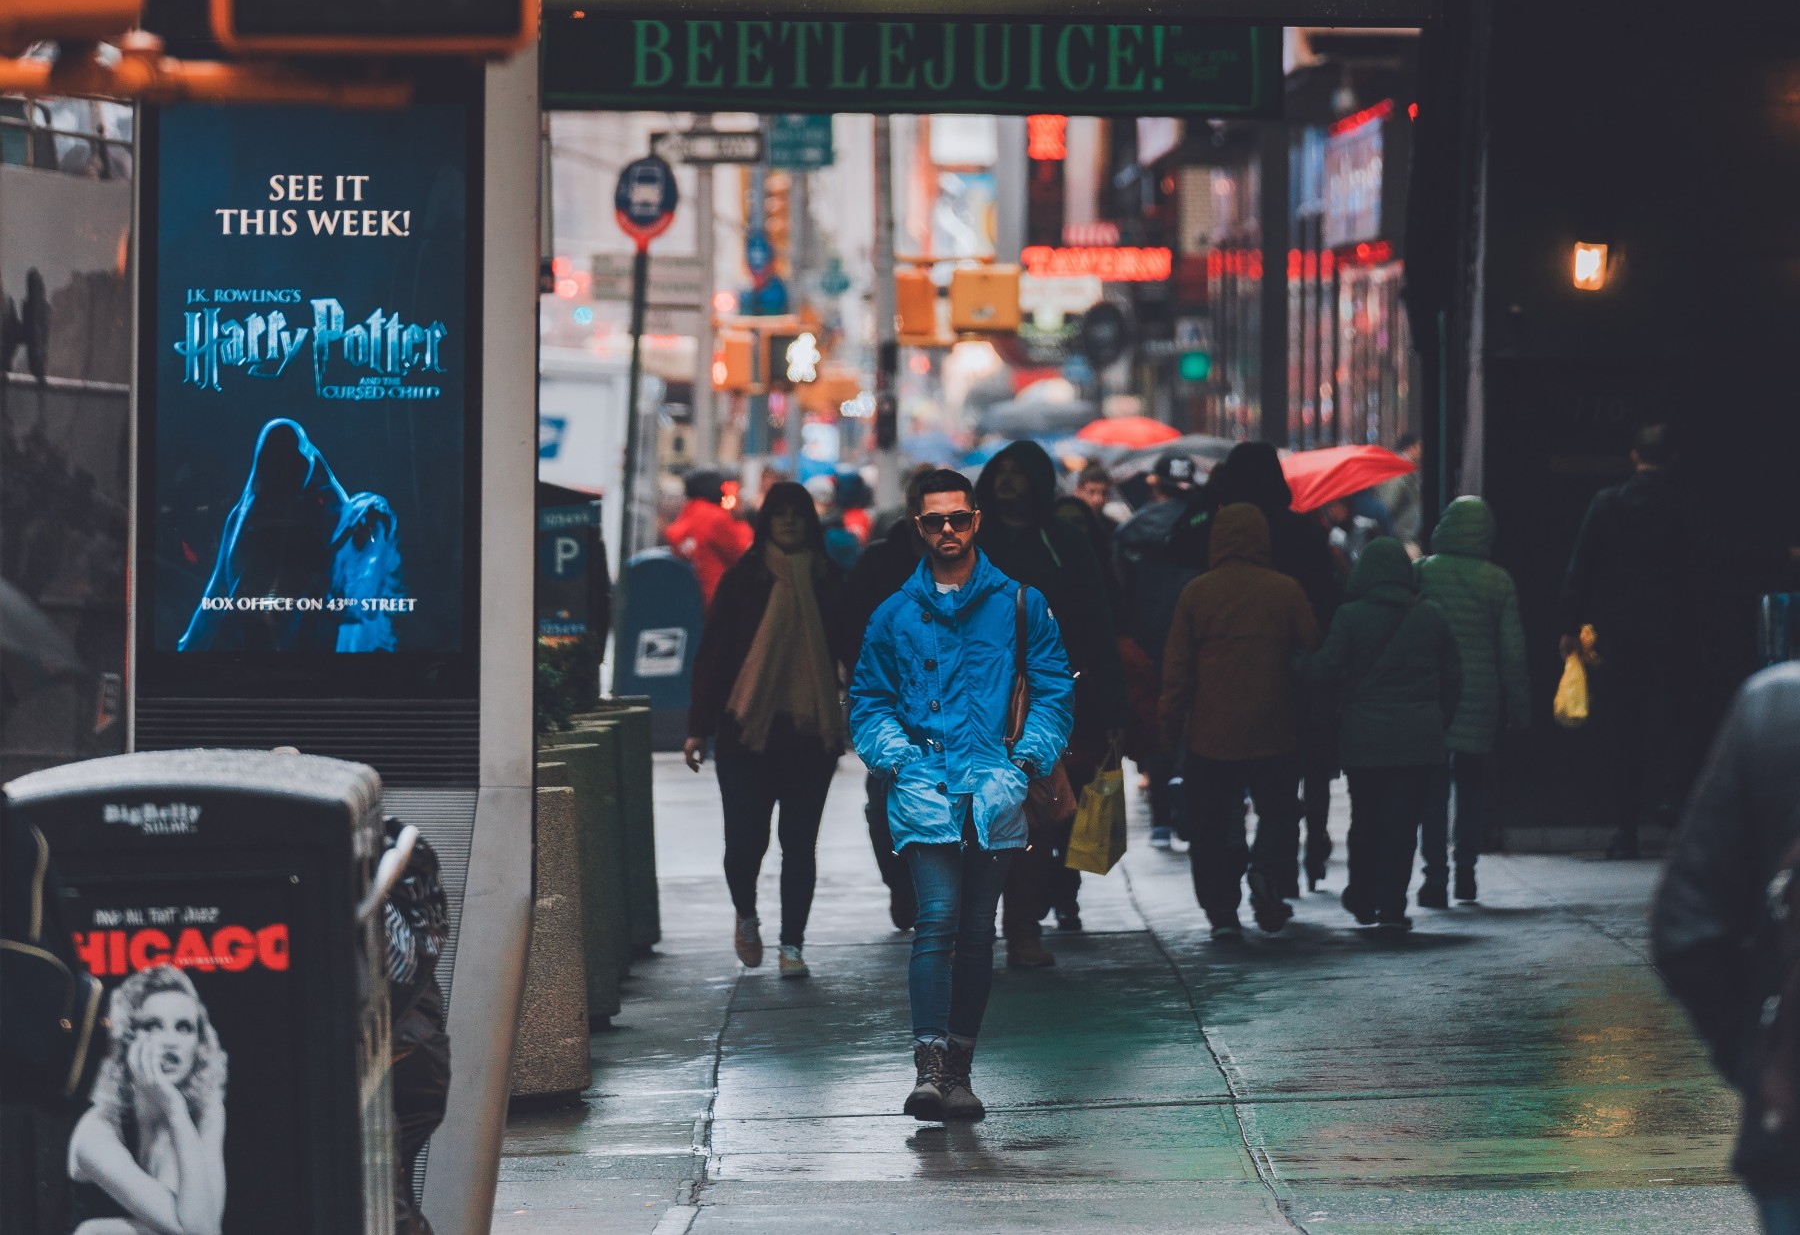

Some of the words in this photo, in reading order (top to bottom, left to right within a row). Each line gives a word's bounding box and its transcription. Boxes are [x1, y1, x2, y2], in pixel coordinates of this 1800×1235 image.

[269, 175, 324, 201] SEE
[336, 175, 370, 201] IT
[215, 209, 298, 236] THIS
[307, 210, 411, 236] WEEK!
[186, 288, 210, 304] J.K.
[214, 288, 302, 304] ROWLING'S
[174, 307, 309, 392] Harry
[310, 298, 448, 398] Potter
[322, 385, 386, 401] CURSED
[555, 536, 580, 574] P
[201, 597, 233, 612] BOX
[296, 597, 323, 611] ON
[361, 597, 418, 613] STREET
[72, 922, 289, 977] HICAGO
